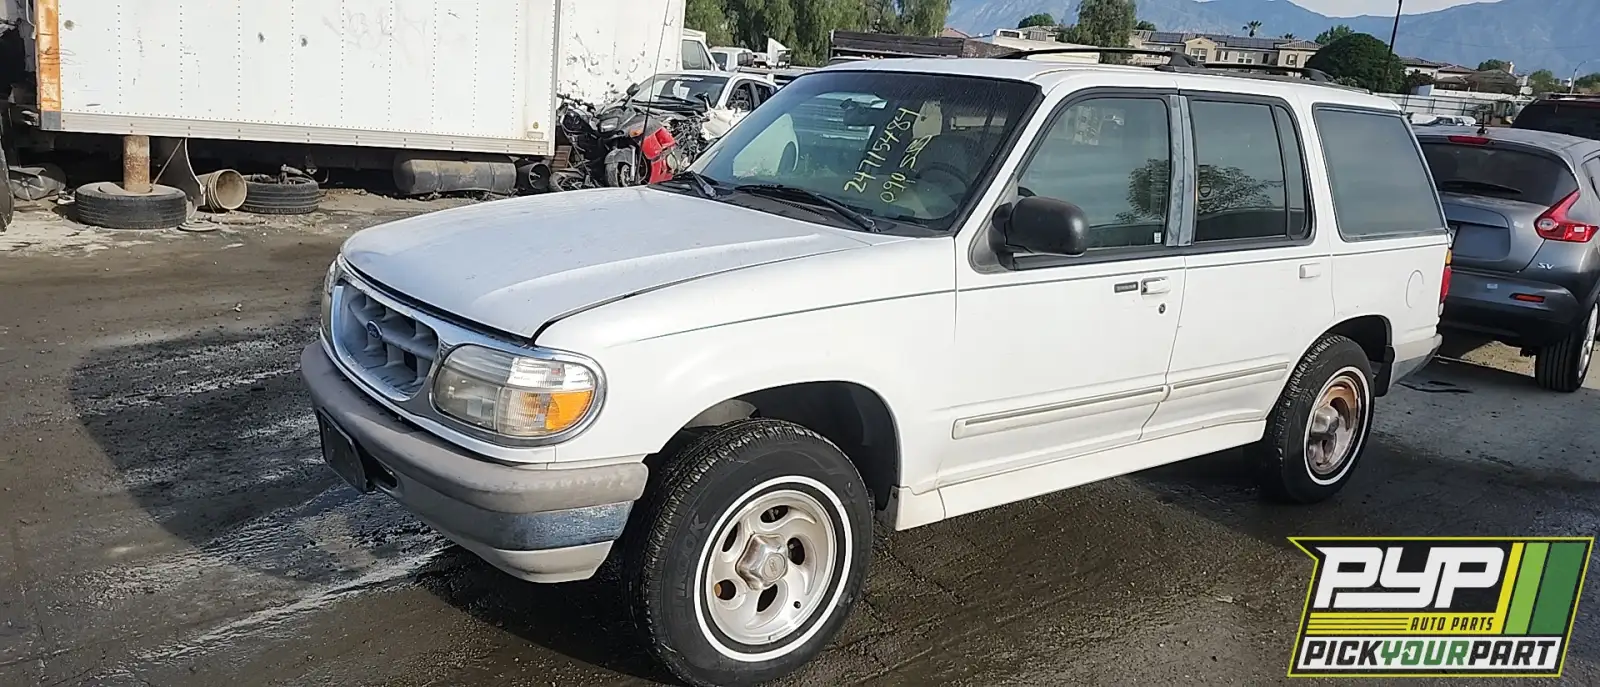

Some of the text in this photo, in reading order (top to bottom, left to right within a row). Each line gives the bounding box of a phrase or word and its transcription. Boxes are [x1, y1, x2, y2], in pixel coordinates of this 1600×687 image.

[843, 106, 921, 194] 24715484
[880, 171, 907, 204] 090
[1537, 262, 1555, 270] SV
